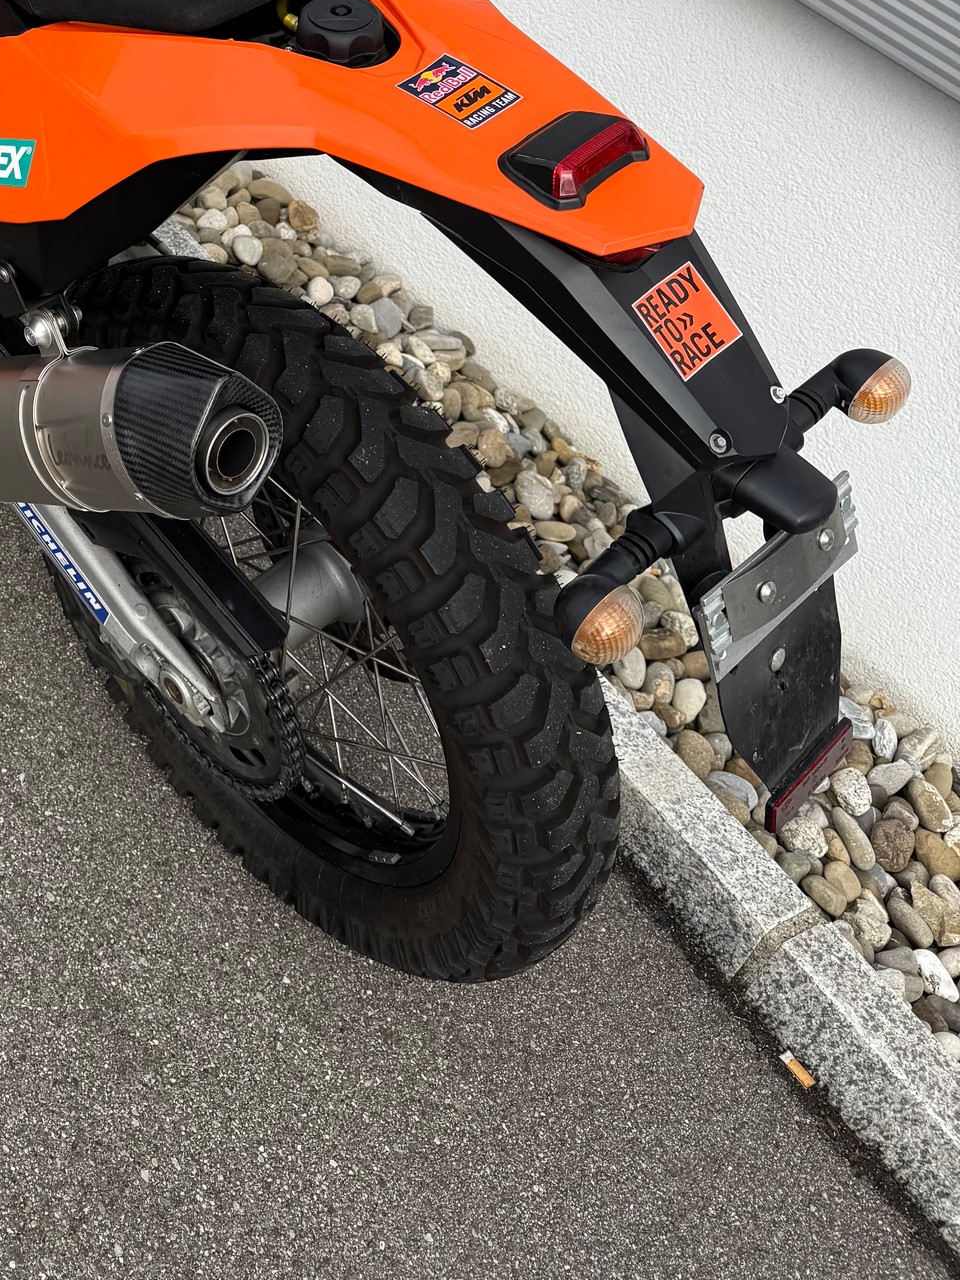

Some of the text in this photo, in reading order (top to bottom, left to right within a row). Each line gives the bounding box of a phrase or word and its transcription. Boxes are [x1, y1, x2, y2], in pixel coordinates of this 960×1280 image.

[452, 85, 492, 113] KTM
[463, 91, 517, 127] RACING TEAM
[635, 266, 701, 329] READY
[669, 322, 726, 376] RACE
